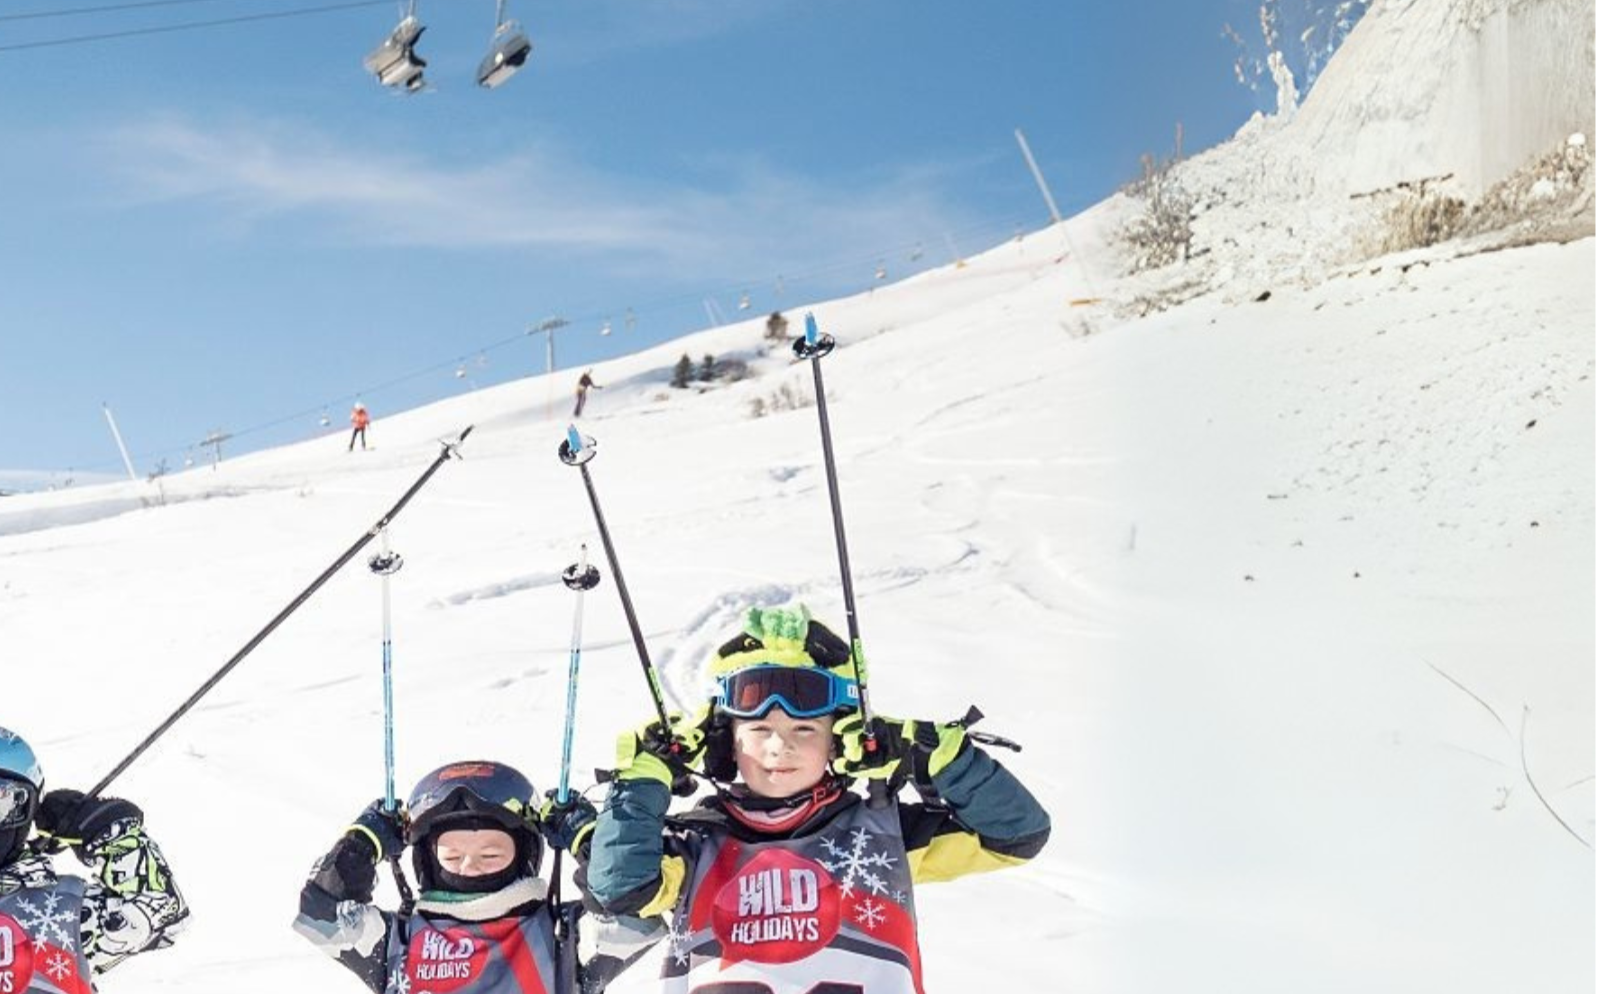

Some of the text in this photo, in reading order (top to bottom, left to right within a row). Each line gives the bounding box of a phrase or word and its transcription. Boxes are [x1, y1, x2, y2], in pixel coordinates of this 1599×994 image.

[737, 868, 818, 917] WILD
[731, 916, 819, 944] HOLIDAYS
[421, 930, 476, 960] WILD
[416, 962, 472, 981] HOLIDAYS
